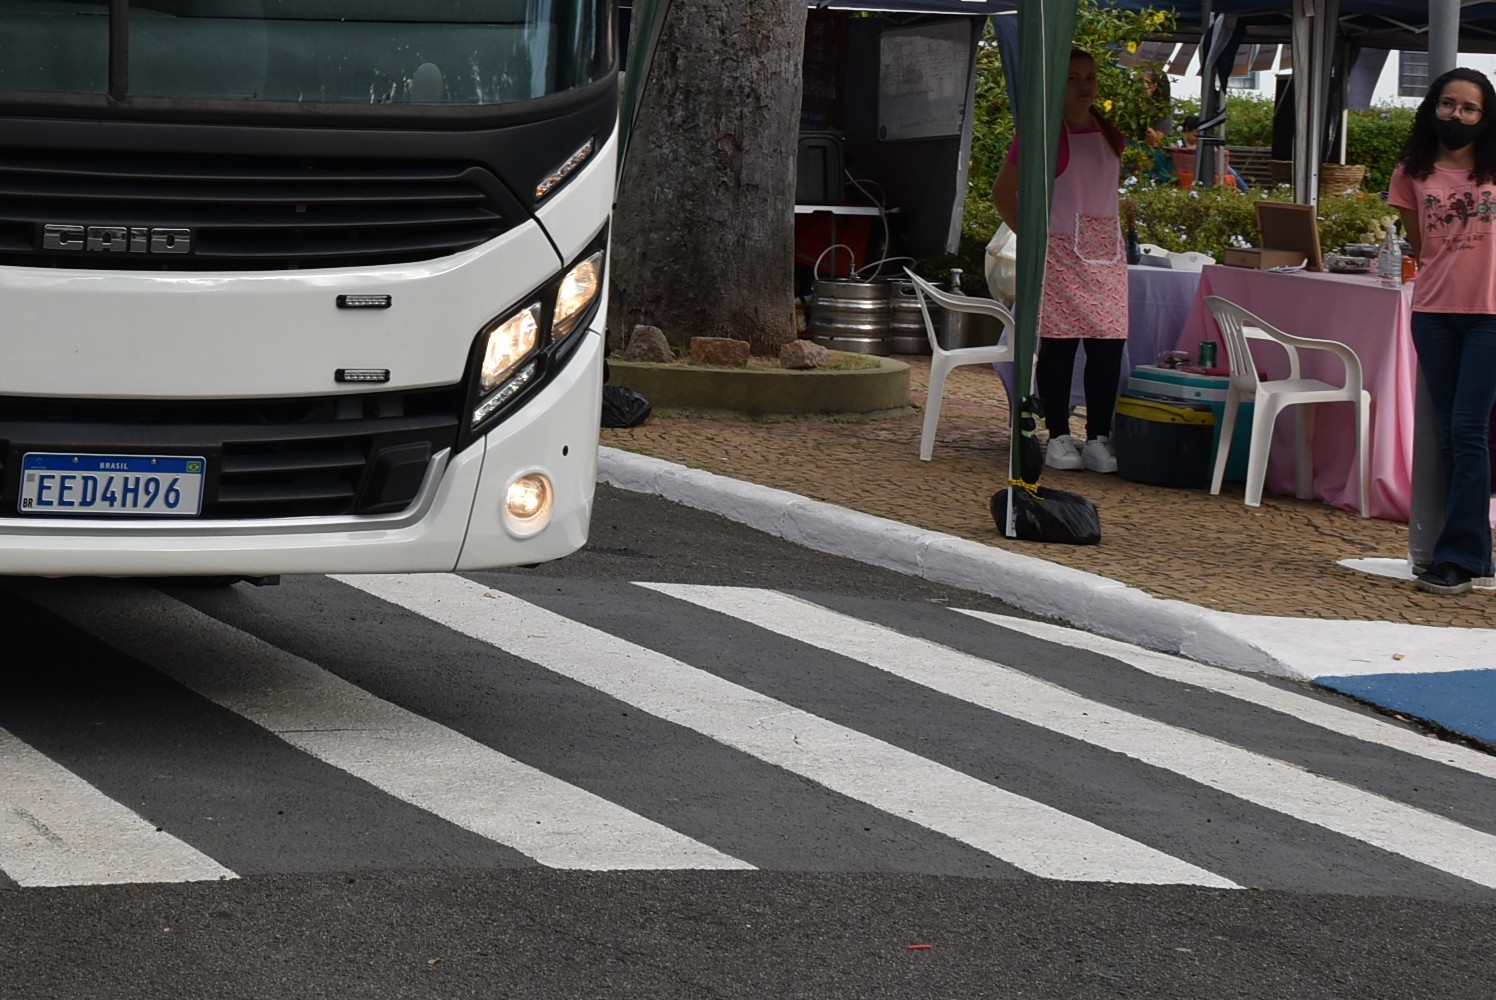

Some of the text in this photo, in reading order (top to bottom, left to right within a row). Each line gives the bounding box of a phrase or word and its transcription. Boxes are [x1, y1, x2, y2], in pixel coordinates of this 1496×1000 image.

[42, 223, 191, 254] CAIO
[99, 462, 129, 470] BRASIL
[36, 474, 181, 509] EED4H96
[22, 497, 34, 508] BR
